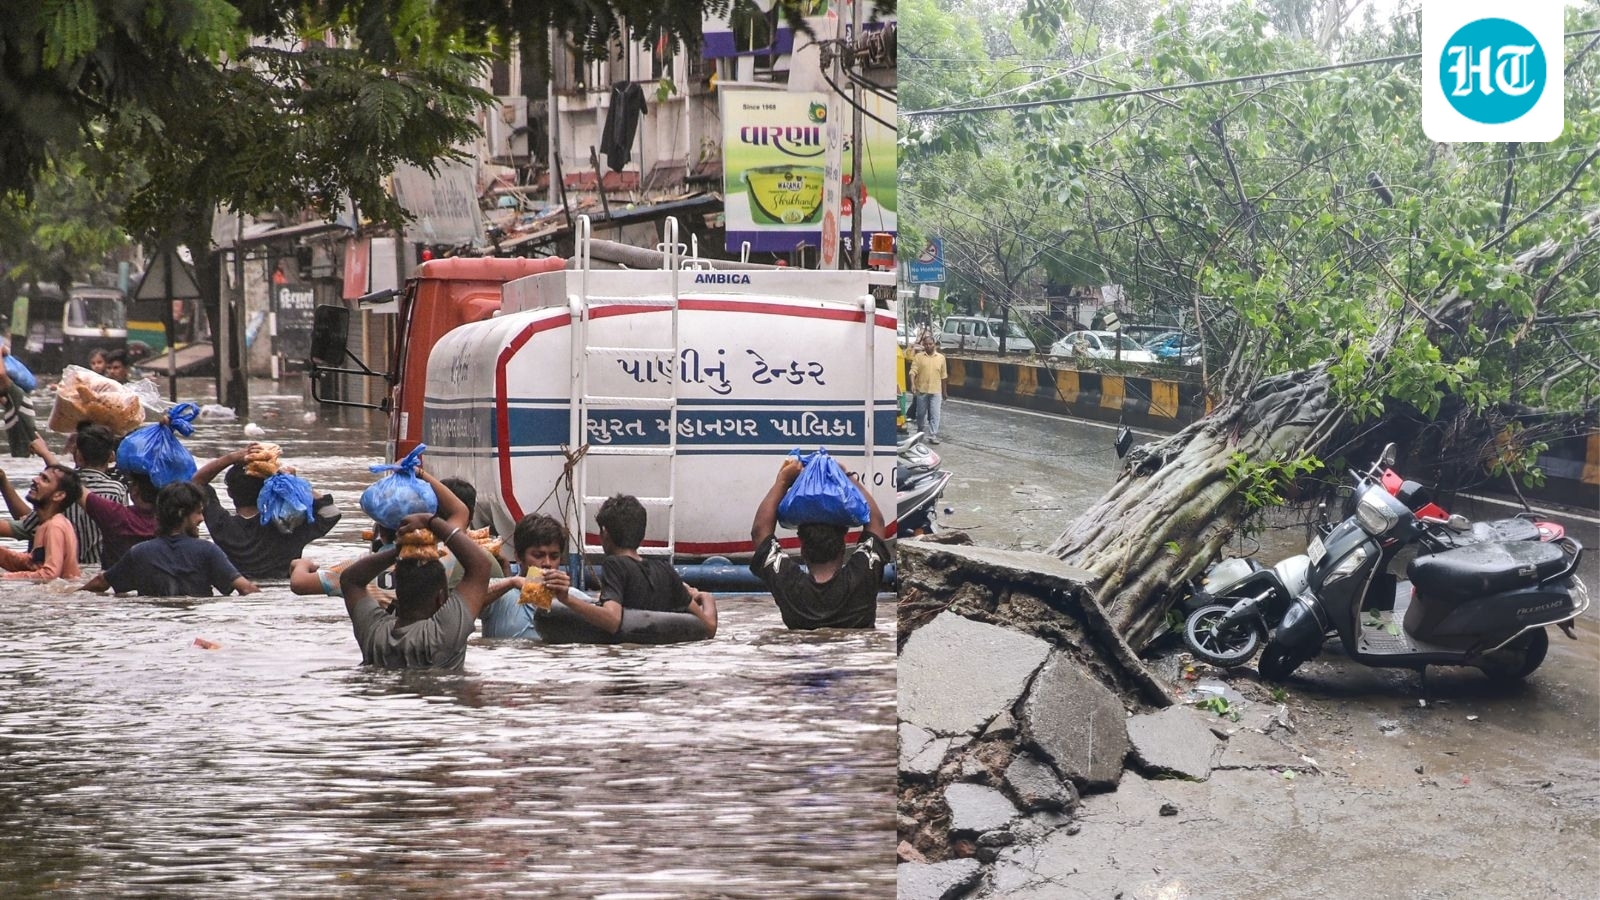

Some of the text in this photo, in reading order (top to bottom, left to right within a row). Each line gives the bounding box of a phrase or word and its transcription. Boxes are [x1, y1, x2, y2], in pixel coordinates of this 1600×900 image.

[694, 273, 751, 285] AMBICA
[746, 349, 826, 385] ટેન્કર
[769, 411, 857, 437] પાલિકા
